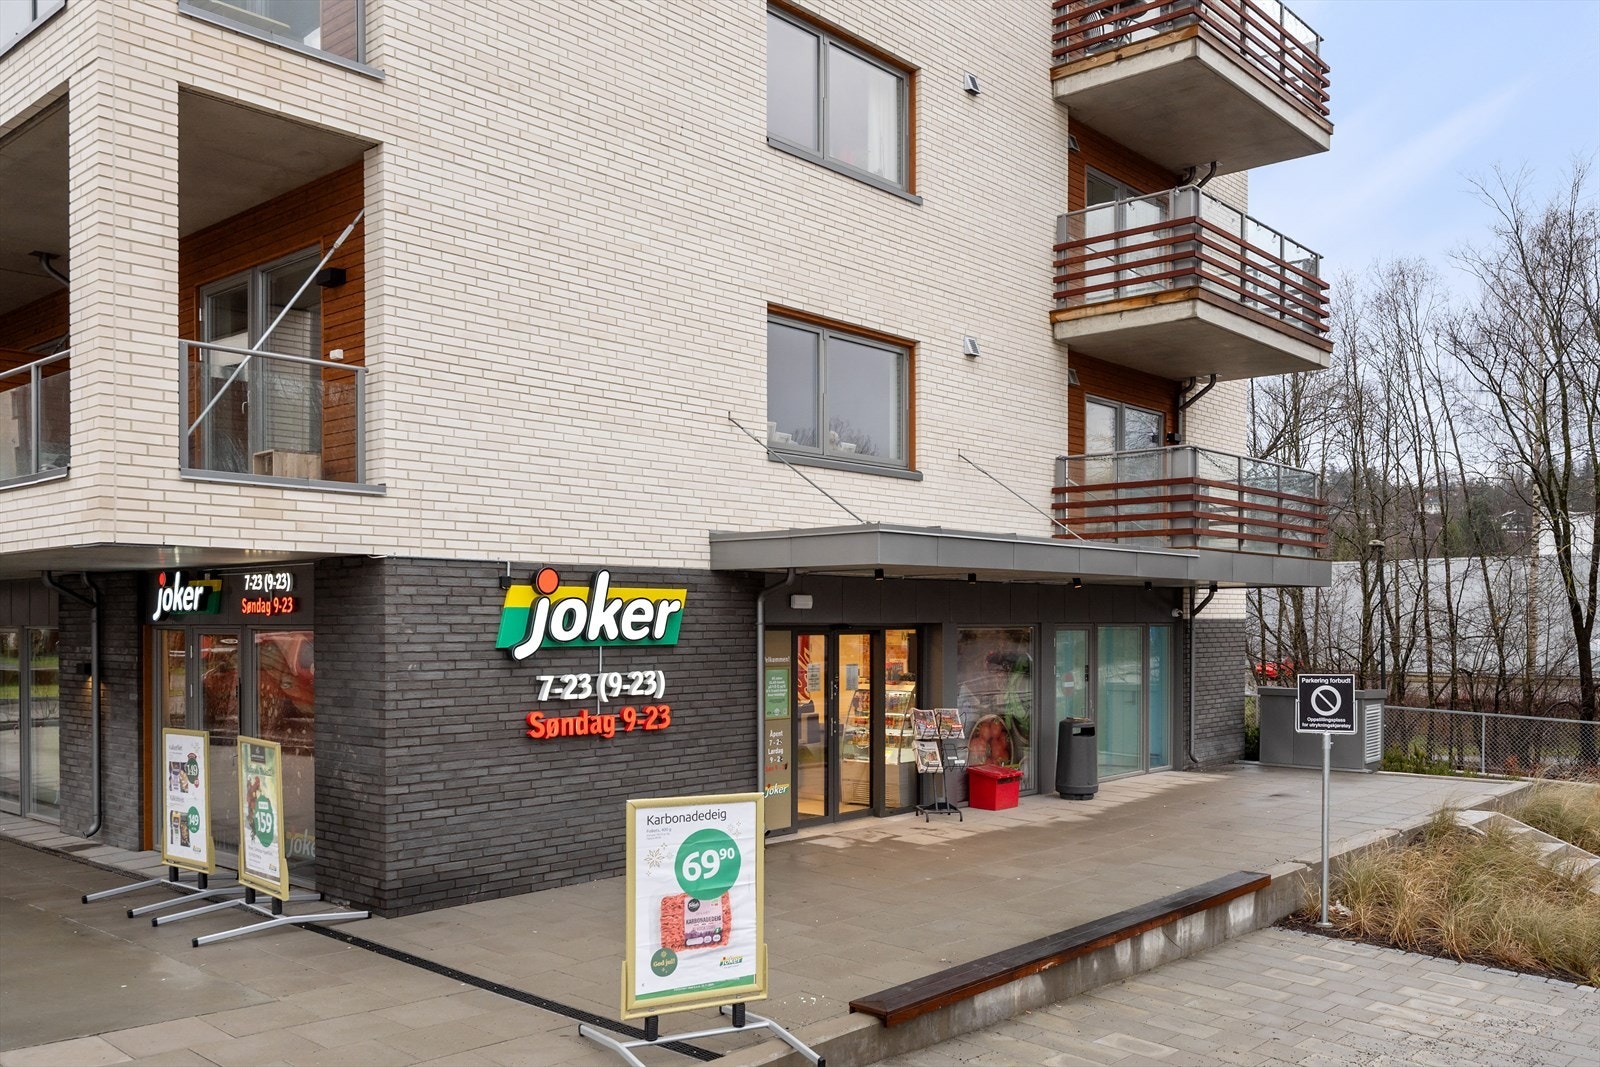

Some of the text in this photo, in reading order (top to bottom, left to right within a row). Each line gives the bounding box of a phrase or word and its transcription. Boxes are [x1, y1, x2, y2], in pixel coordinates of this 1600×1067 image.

[244, 572, 292, 592] 7-23 (9-23)
[152, 571, 204, 621] joker
[241, 597, 294, 616] Søndag 9-23
[512, 567, 682, 661] joker
[536, 670, 666, 703] 7-23 (9-23)
[526, 704, 671, 739] Søndag 9-23
[770, 730, 783, 738] Åpent
[765, 783, 787, 798] joker
[188, 814, 199, 826] 149
[255, 811, 273, 834] 159
[646, 809, 727, 826] Karbonadedeig
[286, 829, 315, 857] joke
